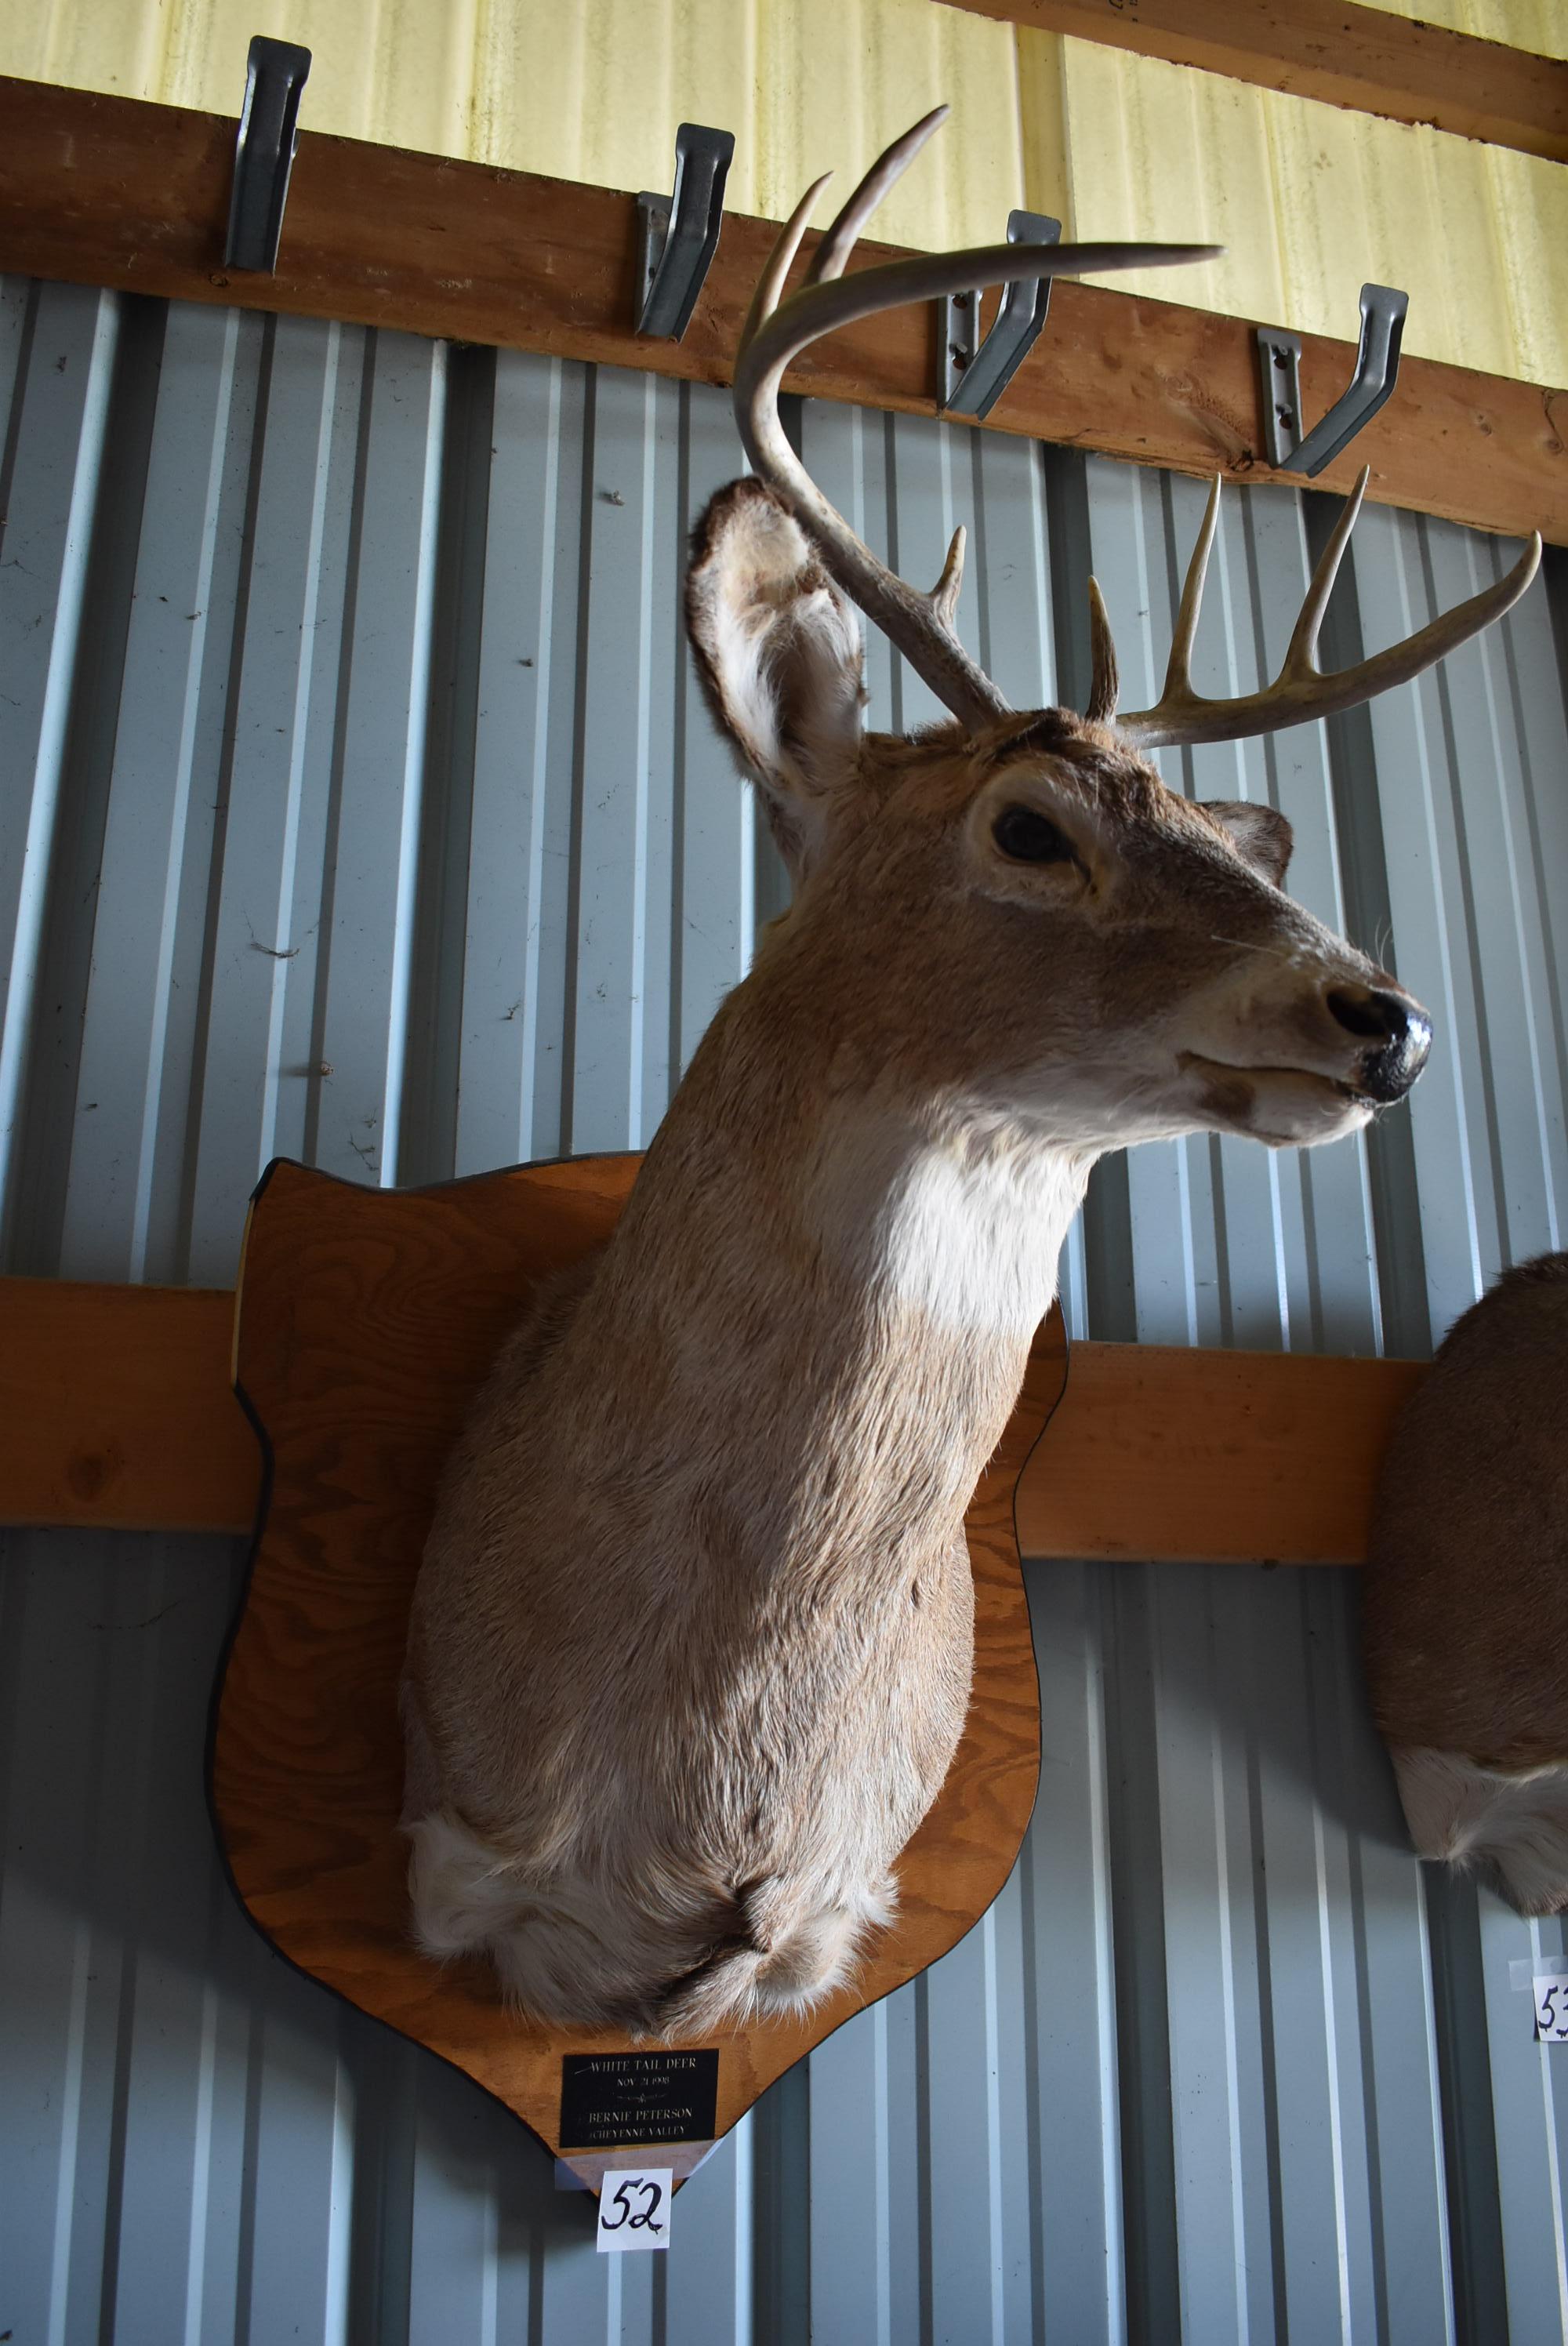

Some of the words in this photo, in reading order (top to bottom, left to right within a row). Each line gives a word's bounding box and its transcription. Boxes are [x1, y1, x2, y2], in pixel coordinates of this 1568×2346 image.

[590, 2061, 630, 2072] WHITE
[634, 2059, 661, 2071] TAIL
[666, 2057, 696, 2069] DEER
[589, 2111, 632, 2123] BERNIE
[636, 2108, 692, 2121] PETERSON
[591, 2127, 646, 2140] CHEYENNE
[648, 2126, 684, 2137] VALLEY
[601, 2177, 663, 2235] 52
